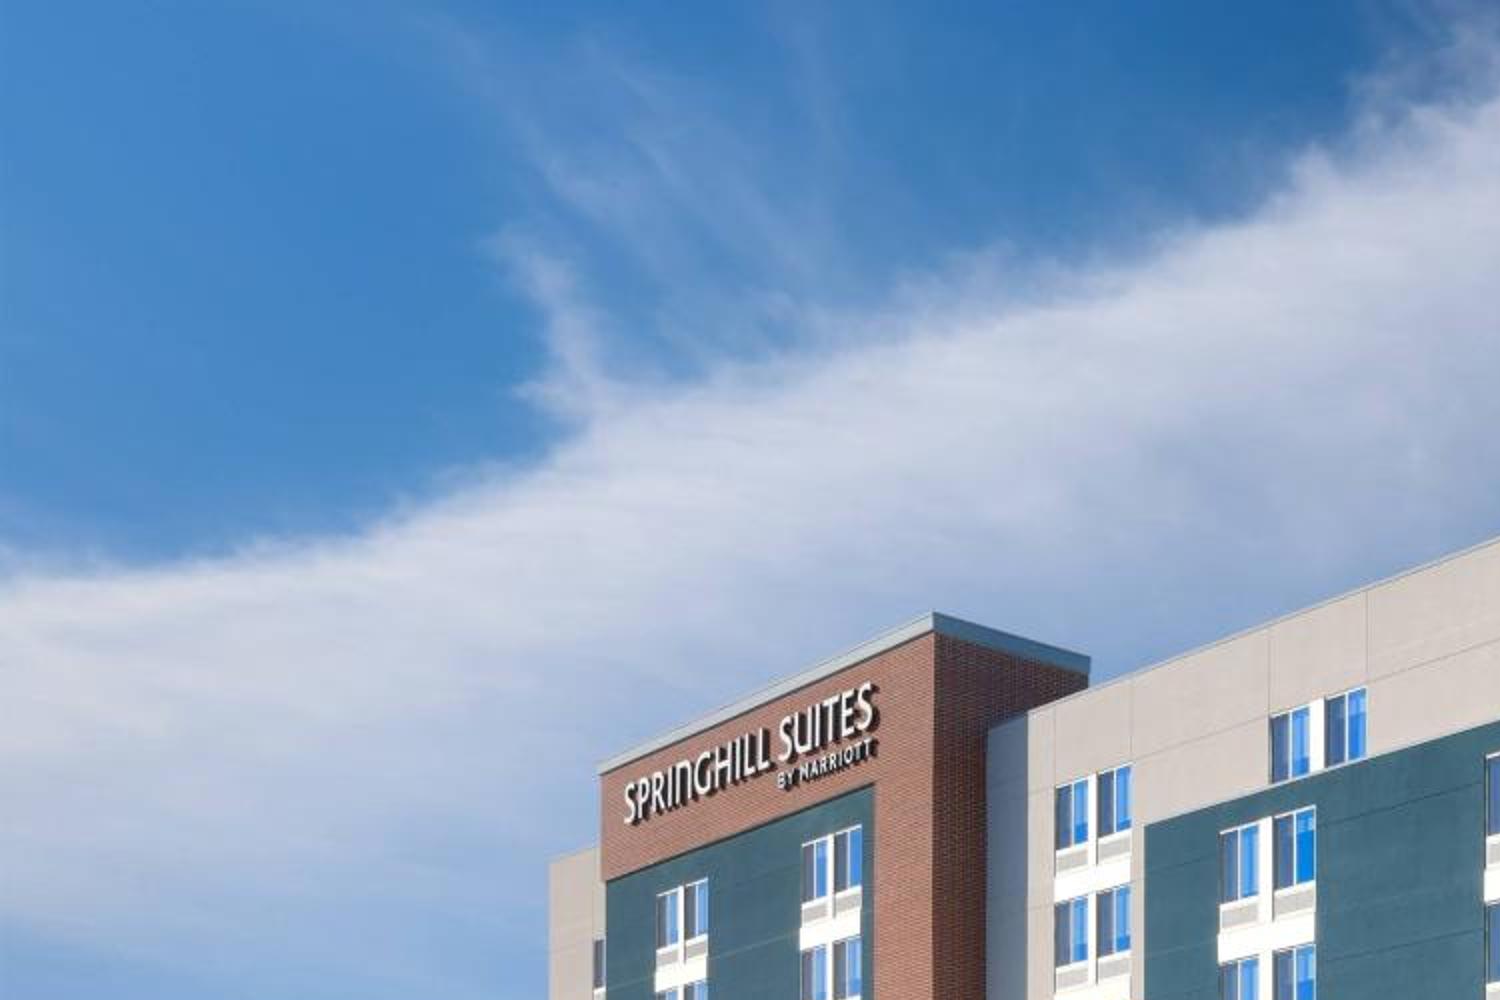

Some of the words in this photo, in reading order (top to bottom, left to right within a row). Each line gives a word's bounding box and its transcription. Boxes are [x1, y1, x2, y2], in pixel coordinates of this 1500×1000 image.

[623, 727, 771, 824] SPRINGHILL
[777, 681, 874, 763] SUITES
[777, 769, 795, 789] BY
[800, 736, 874, 781] MARRIOTT
